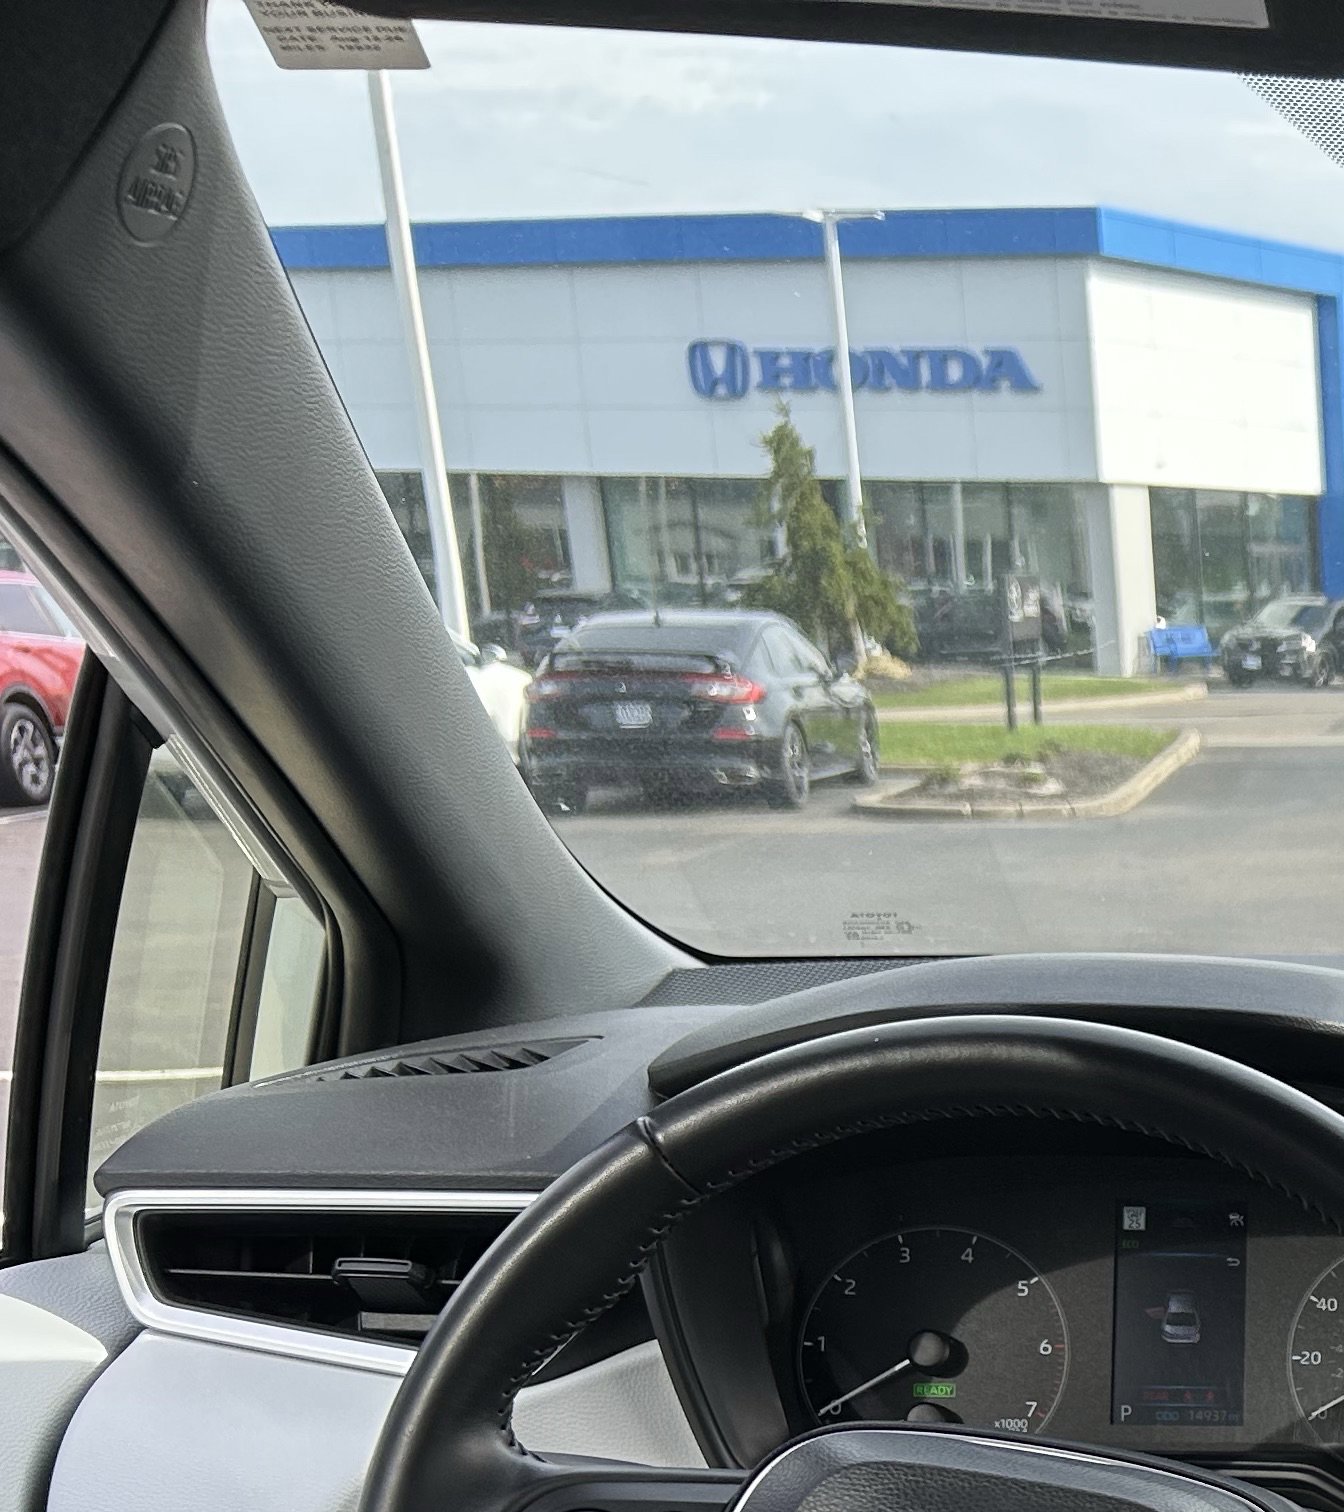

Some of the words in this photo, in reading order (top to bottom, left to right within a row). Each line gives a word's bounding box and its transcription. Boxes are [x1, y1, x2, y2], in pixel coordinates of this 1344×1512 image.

[752, 346, 1041, 394] HONDA
[900, 1247, 911, 1263] 3
[960, 1247, 974, 1263] 4
[844, 1279, 856, 1295] 2
[1017, 1280, 1029, 1296] 5
[1316, 1298, 1338, 1312] 40
[817, 1336, 826, 1351] 1
[1039, 1339, 1052, 1355] 6
[1300, 1351, 1322, 1365] 20
[916, 1385, 953, 1396] READY
[1025, 1401, 1038, 1417] 7
[1121, 1405, 1132, 1421] P
[1189, 1410, 1227, 1421] 14937
